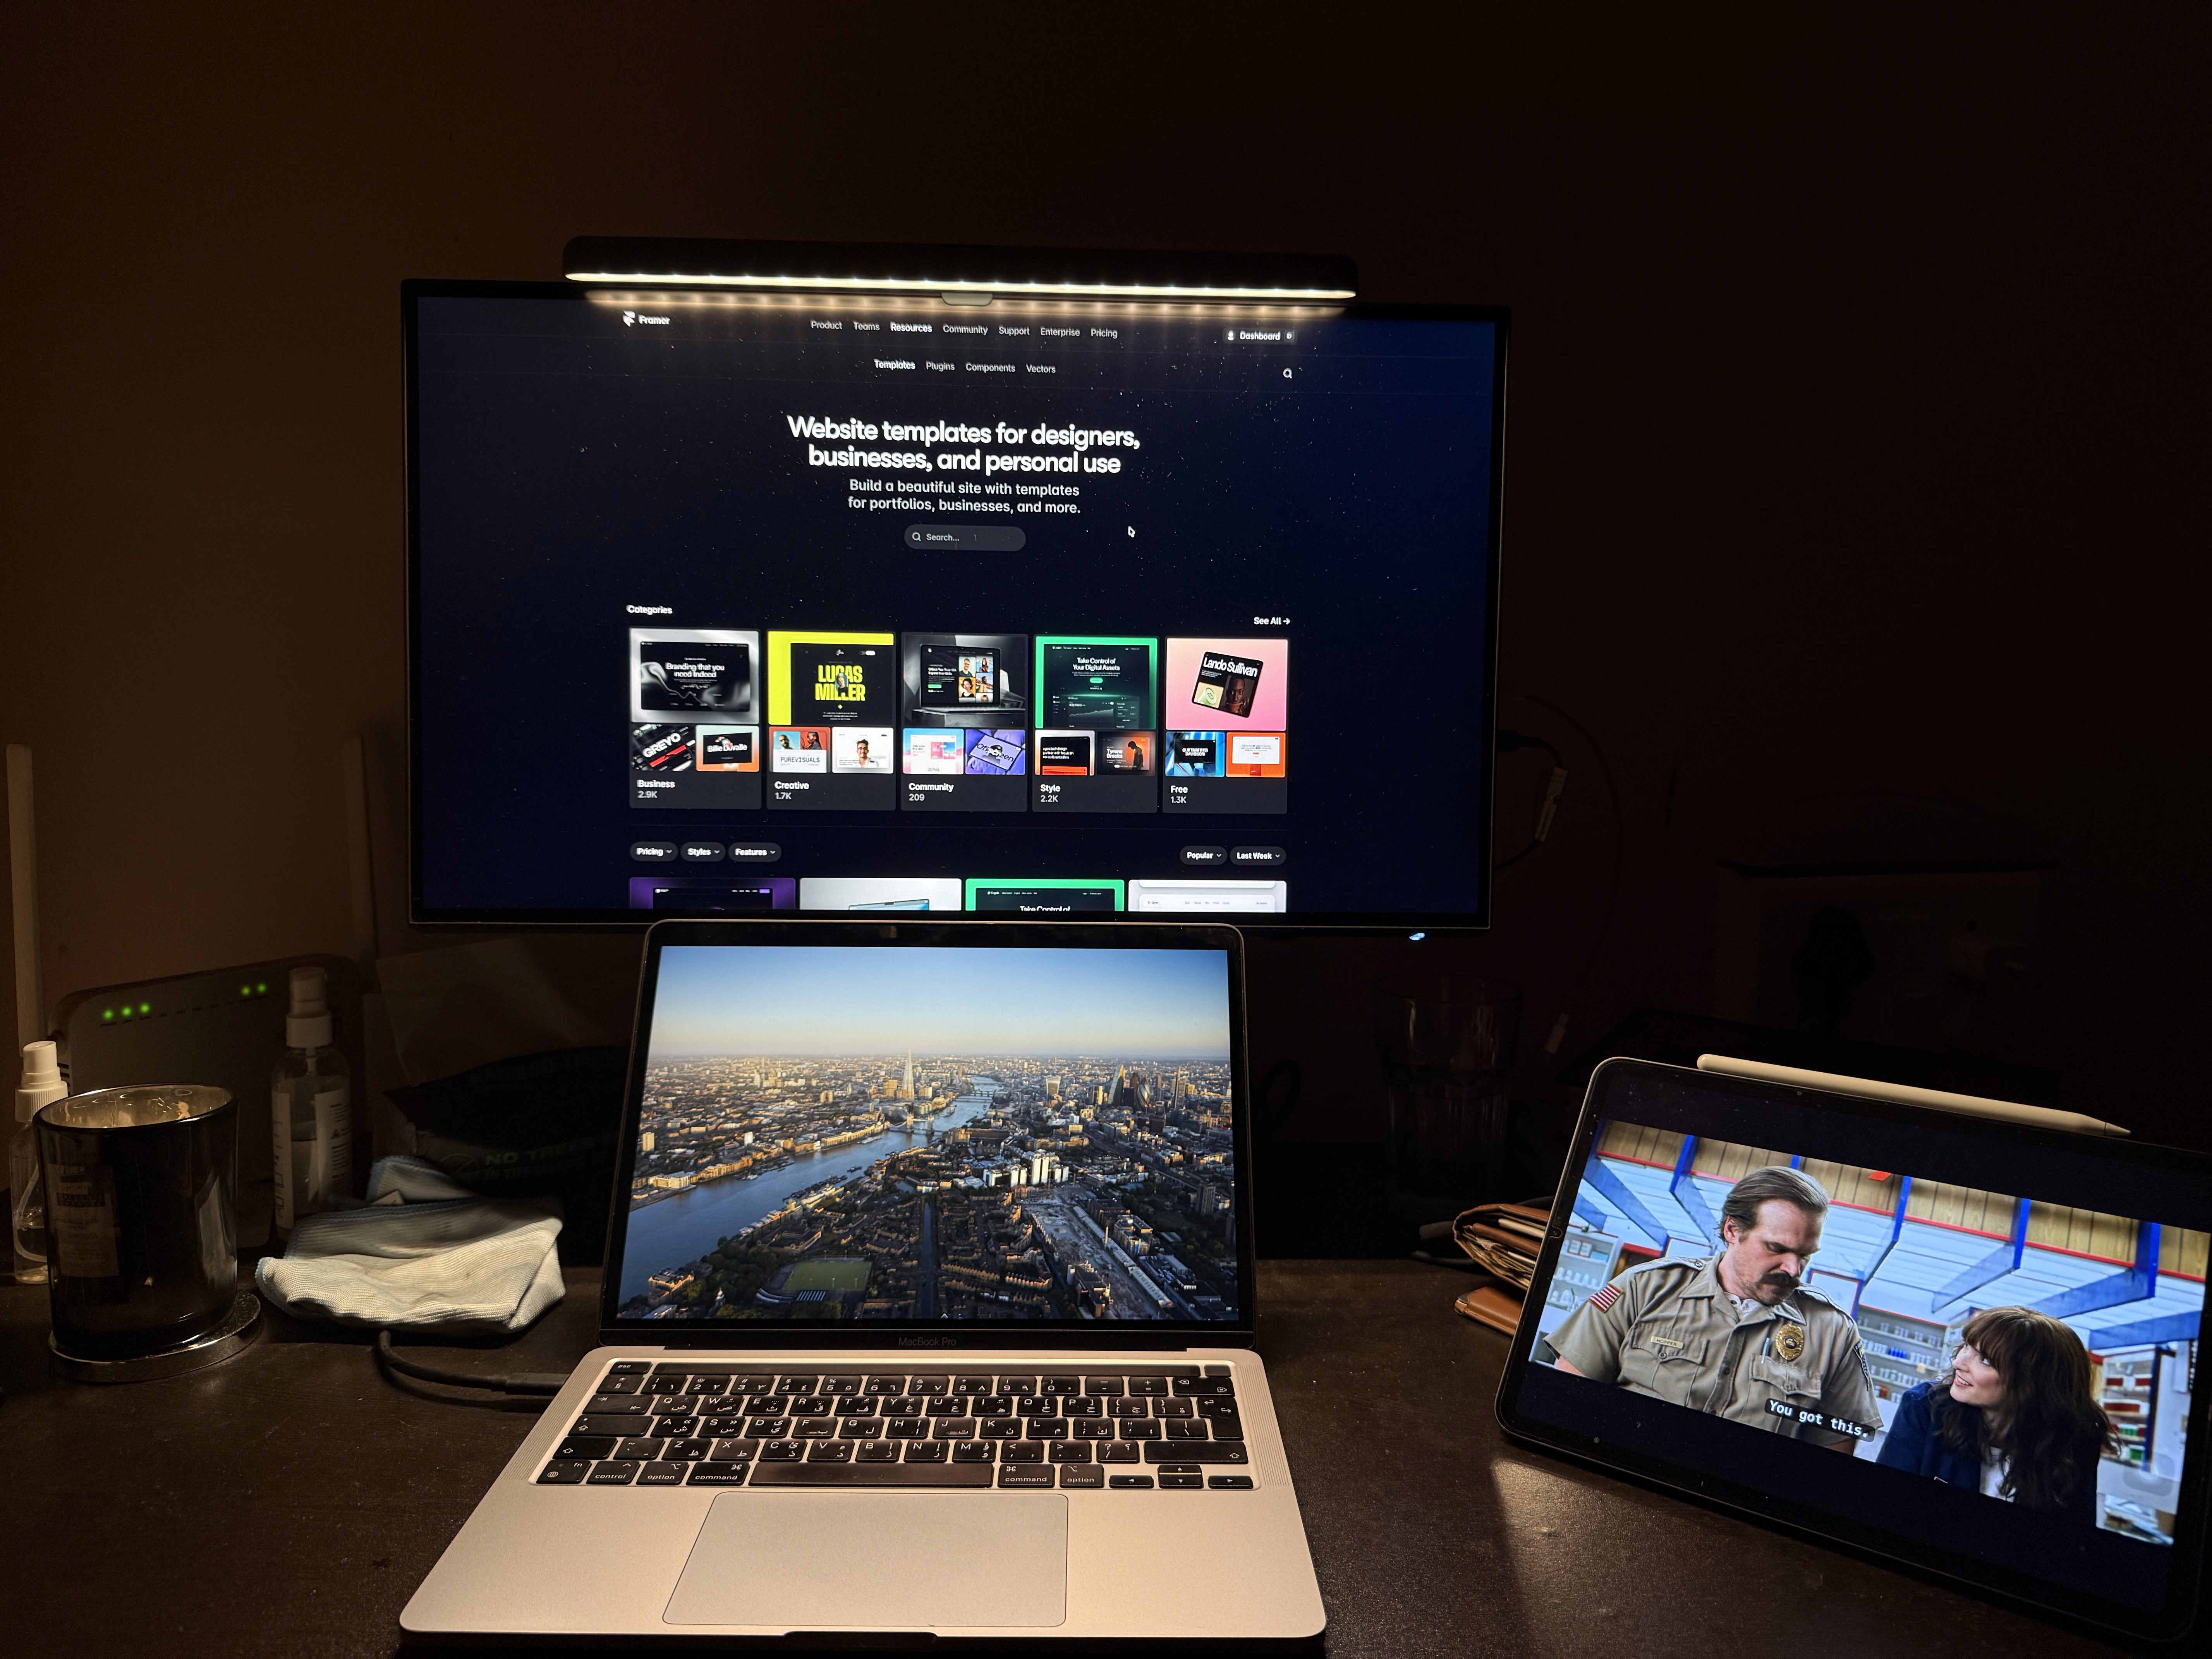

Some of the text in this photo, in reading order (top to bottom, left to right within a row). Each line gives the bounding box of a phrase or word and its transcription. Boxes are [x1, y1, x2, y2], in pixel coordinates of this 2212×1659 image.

[638, 315, 670, 325] Framer
[811, 320, 1118, 339] Product Teams Resources Community Support Enterprise Pricing
[1240, 331, 1280, 340] Dashboard
[874, 359, 1056, 374] Templates Plugins Components Vectors
[787, 416, 1140, 450] Website templates for designers,
[809, 445, 1120, 476] businesses, and personal use
[849, 478, 1079, 497] Build a beautiful site with templates
[848, 496, 1081, 514] for portfolios, businesses, and more.
[926, 533, 959, 541] Search...
[626, 605, 673, 615] Categories
[665, 662, 697, 671] Branding
[1203, 657, 1227, 670] Lando
[1227, 662, 1258, 677] Sullivan
[642, 733, 680, 757] GREYO
[637, 779, 675, 788] Business
[775, 781, 809, 789] Creative
[909, 783, 954, 792] Community
[1041, 784, 1060, 793] Style
[637, 848, 663, 857] Pricing
[688, 848, 711, 857] Styles
[486, 1152, 519, 1165] NO
[898, 1337, 957, 1346] MacBook Pro
[1770, 1400, 1868, 1437] You got this.
